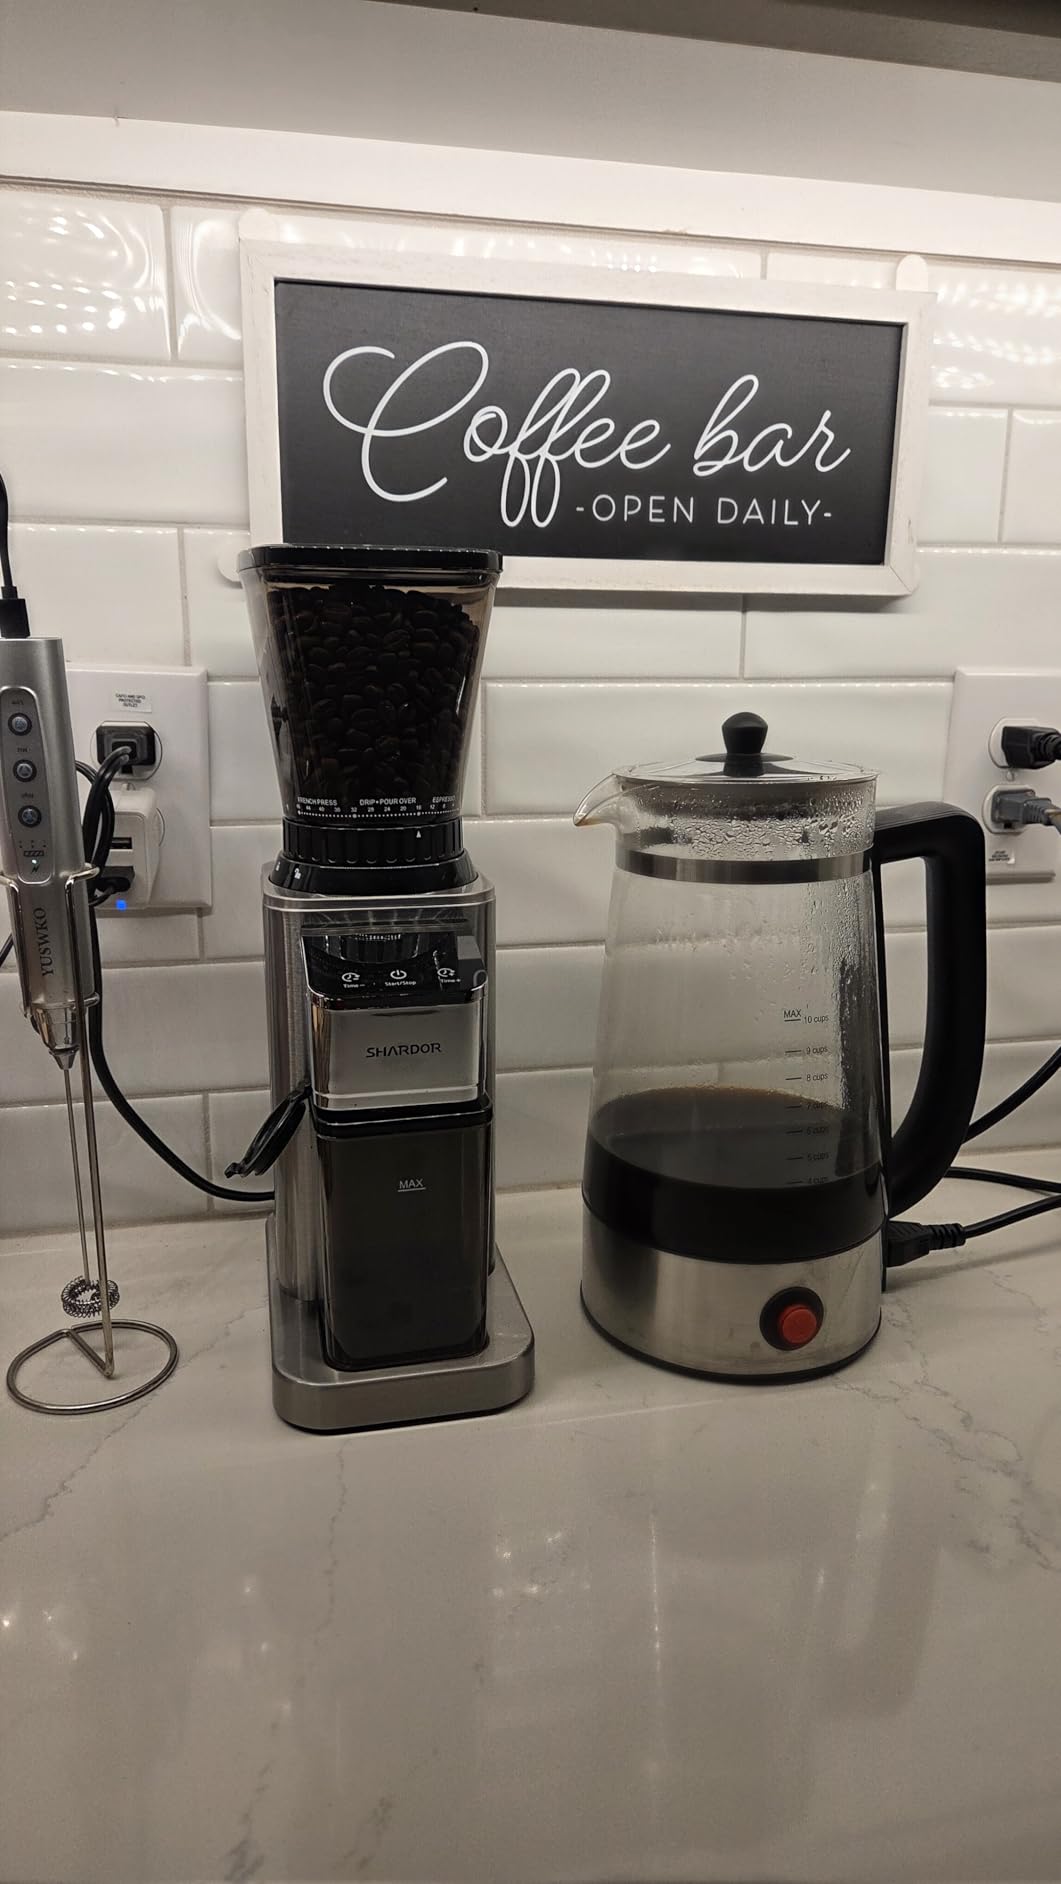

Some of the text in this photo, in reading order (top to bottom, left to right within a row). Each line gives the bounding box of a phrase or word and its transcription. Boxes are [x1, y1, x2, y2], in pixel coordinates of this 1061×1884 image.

[323, 341, 851, 527] Coffee bar
[316, 798, 338, 806] PRESS
[33, 906, 54, 977] YUSWKO
[783, 1009, 802, 1018] MAX
[804, 1015, 829, 1024] 10 cups
[365, 1042, 442, 1058] SHARDOR
[806, 1046, 828, 1056] 9 cups
[806, 1073, 828, 1082] 8 cups
[399, 1178, 424, 1190] MAX
